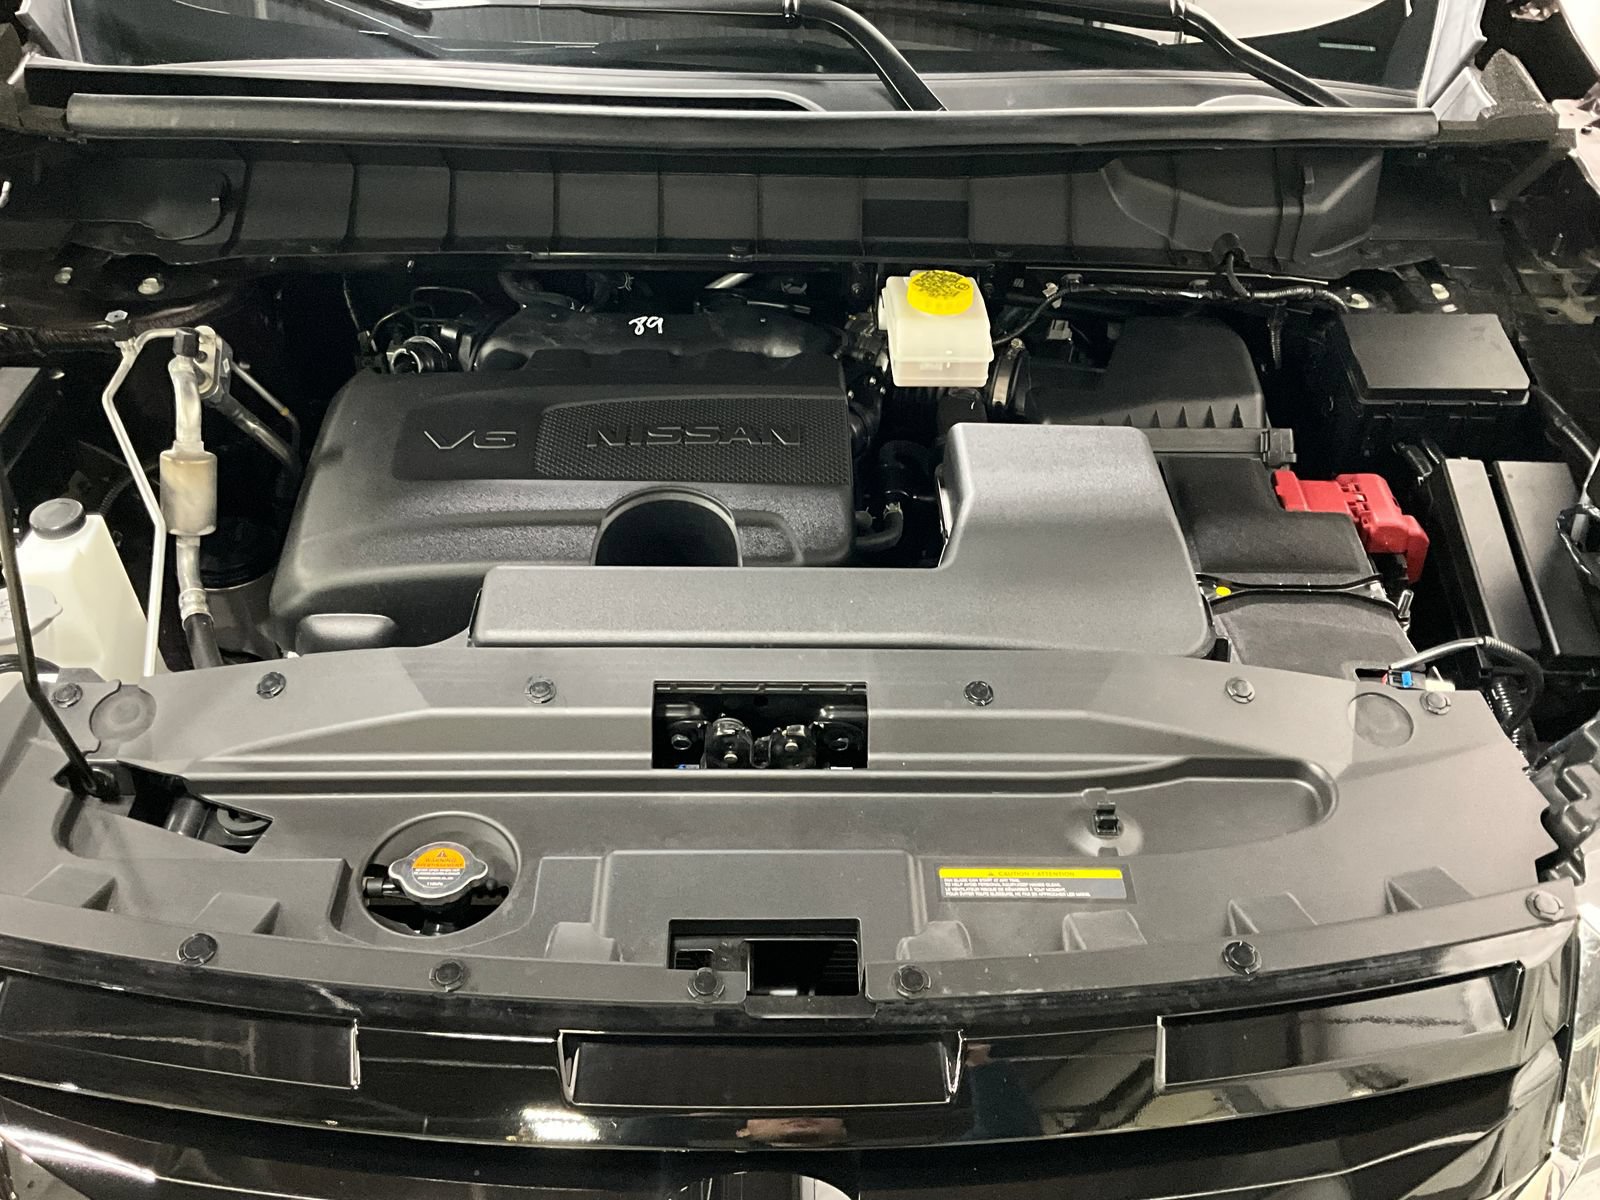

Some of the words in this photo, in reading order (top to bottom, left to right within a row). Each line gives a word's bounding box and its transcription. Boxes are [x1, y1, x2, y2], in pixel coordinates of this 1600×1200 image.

[629, 316, 664, 335] 89
[424, 430, 517, 449] V6
[586, 426, 800, 448] NISSAN
